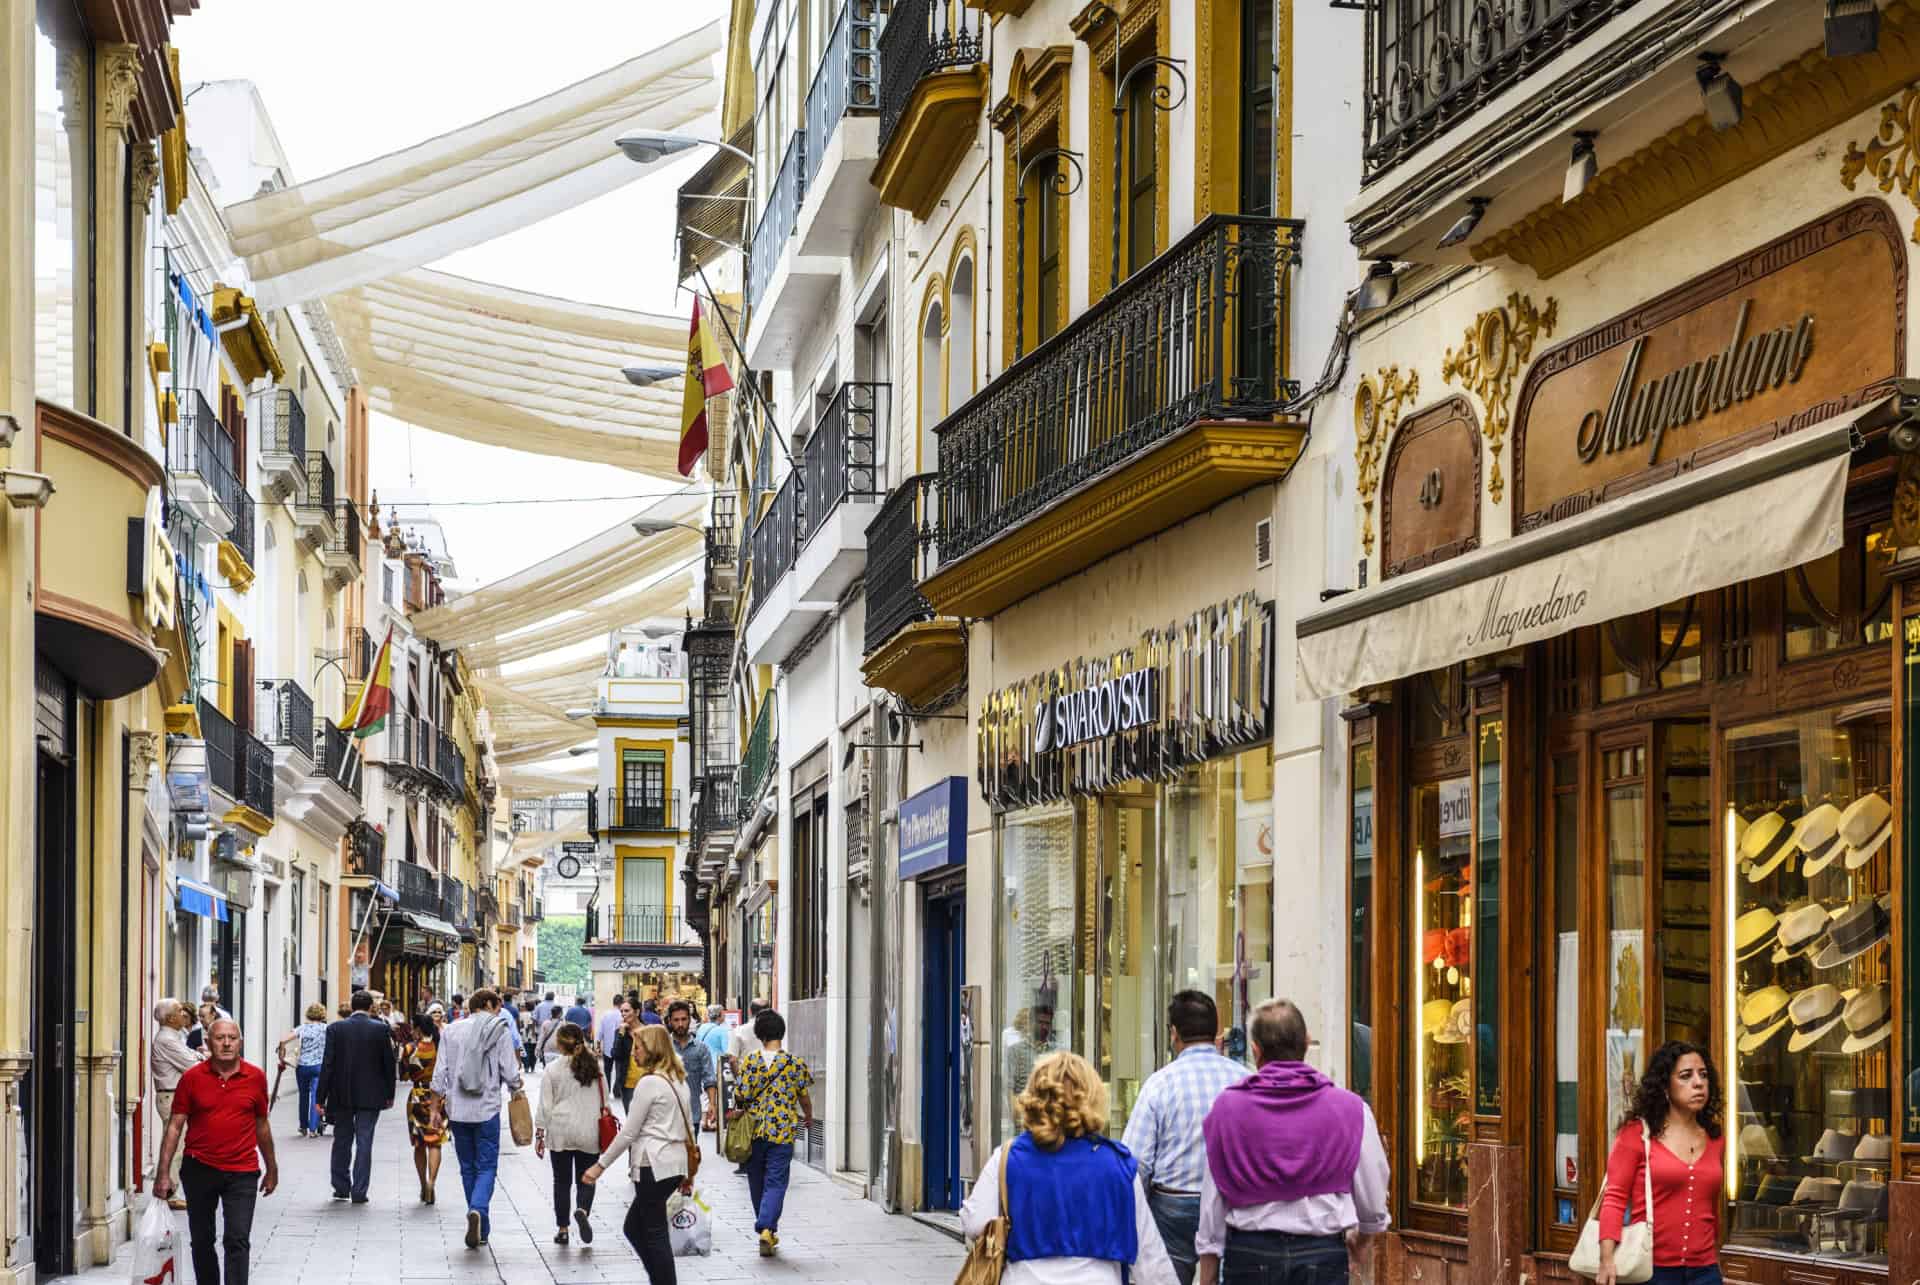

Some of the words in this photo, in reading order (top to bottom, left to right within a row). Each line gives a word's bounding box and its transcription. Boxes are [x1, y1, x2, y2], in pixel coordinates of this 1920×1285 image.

[1577, 299, 1814, 464] Maquedano
[1420, 467, 1442, 509] 40
[1467, 573, 1588, 646] Maquedano
[1056, 667, 1150, 748] SWAROVSKI
